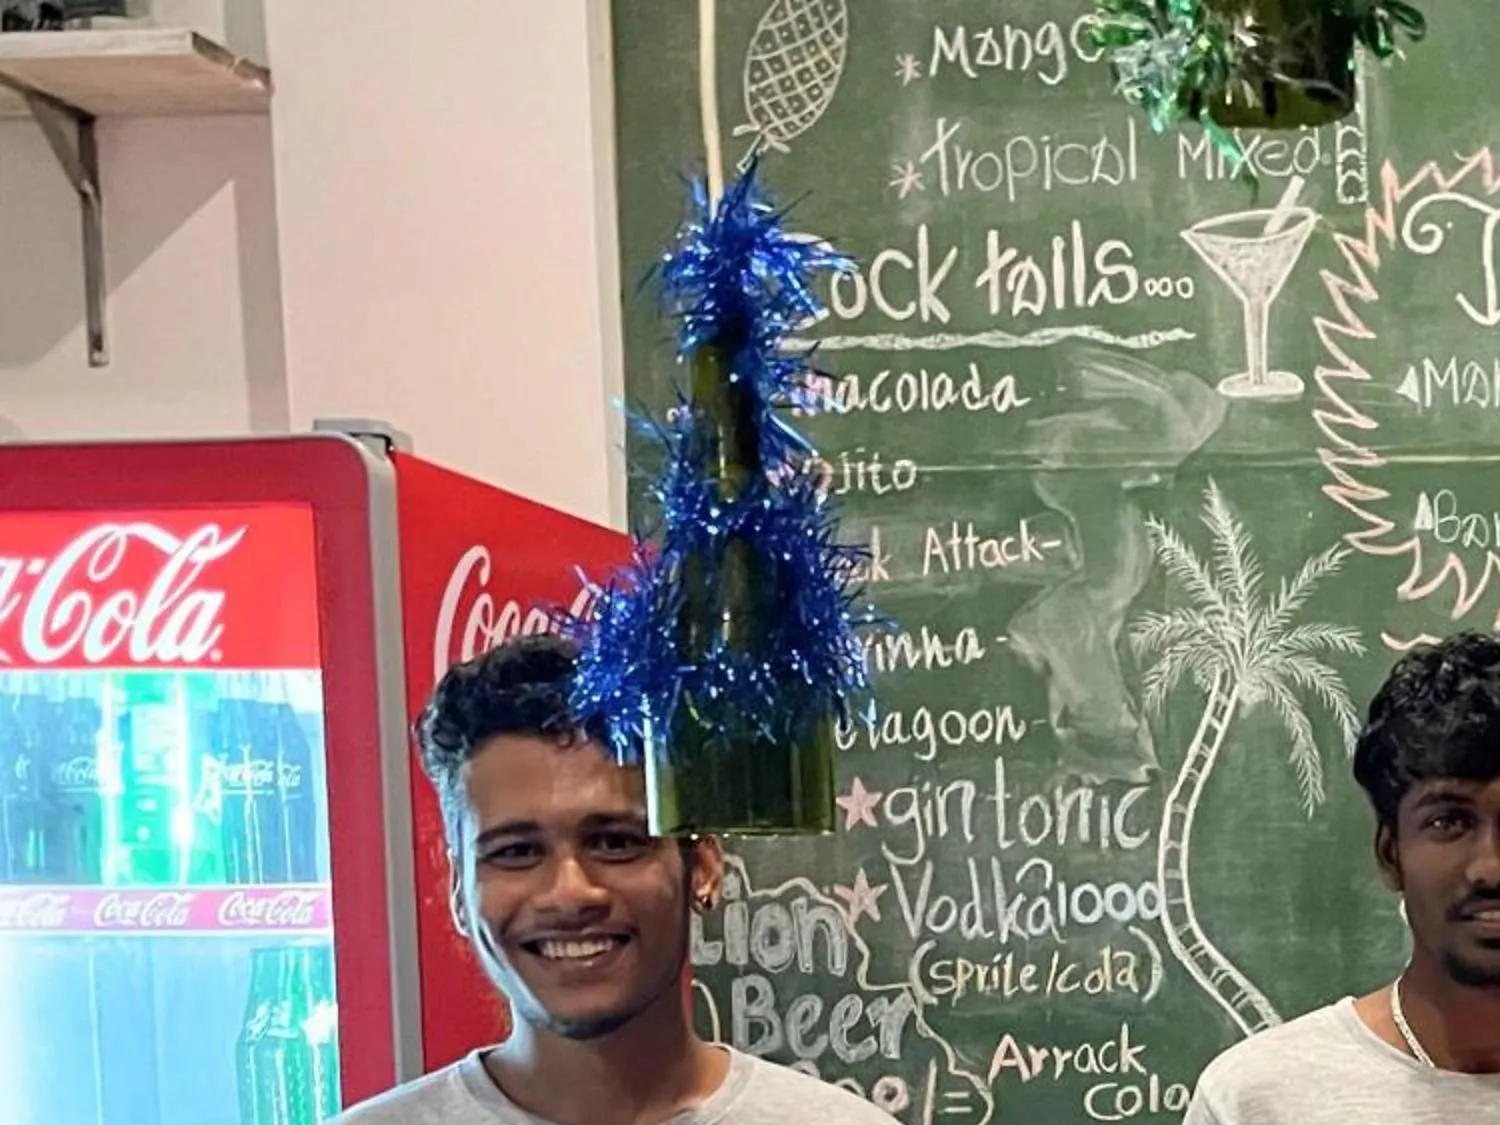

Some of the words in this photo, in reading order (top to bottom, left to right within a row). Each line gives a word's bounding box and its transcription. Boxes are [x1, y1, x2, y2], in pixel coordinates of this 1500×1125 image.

[881, 776, 977, 865] gin
[979, 756, 1151, 850] tonic
[689, 871, 850, 977] Lion
[731, 973, 916, 1064] Beer
[988, 1021, 1147, 1087] Arrack
